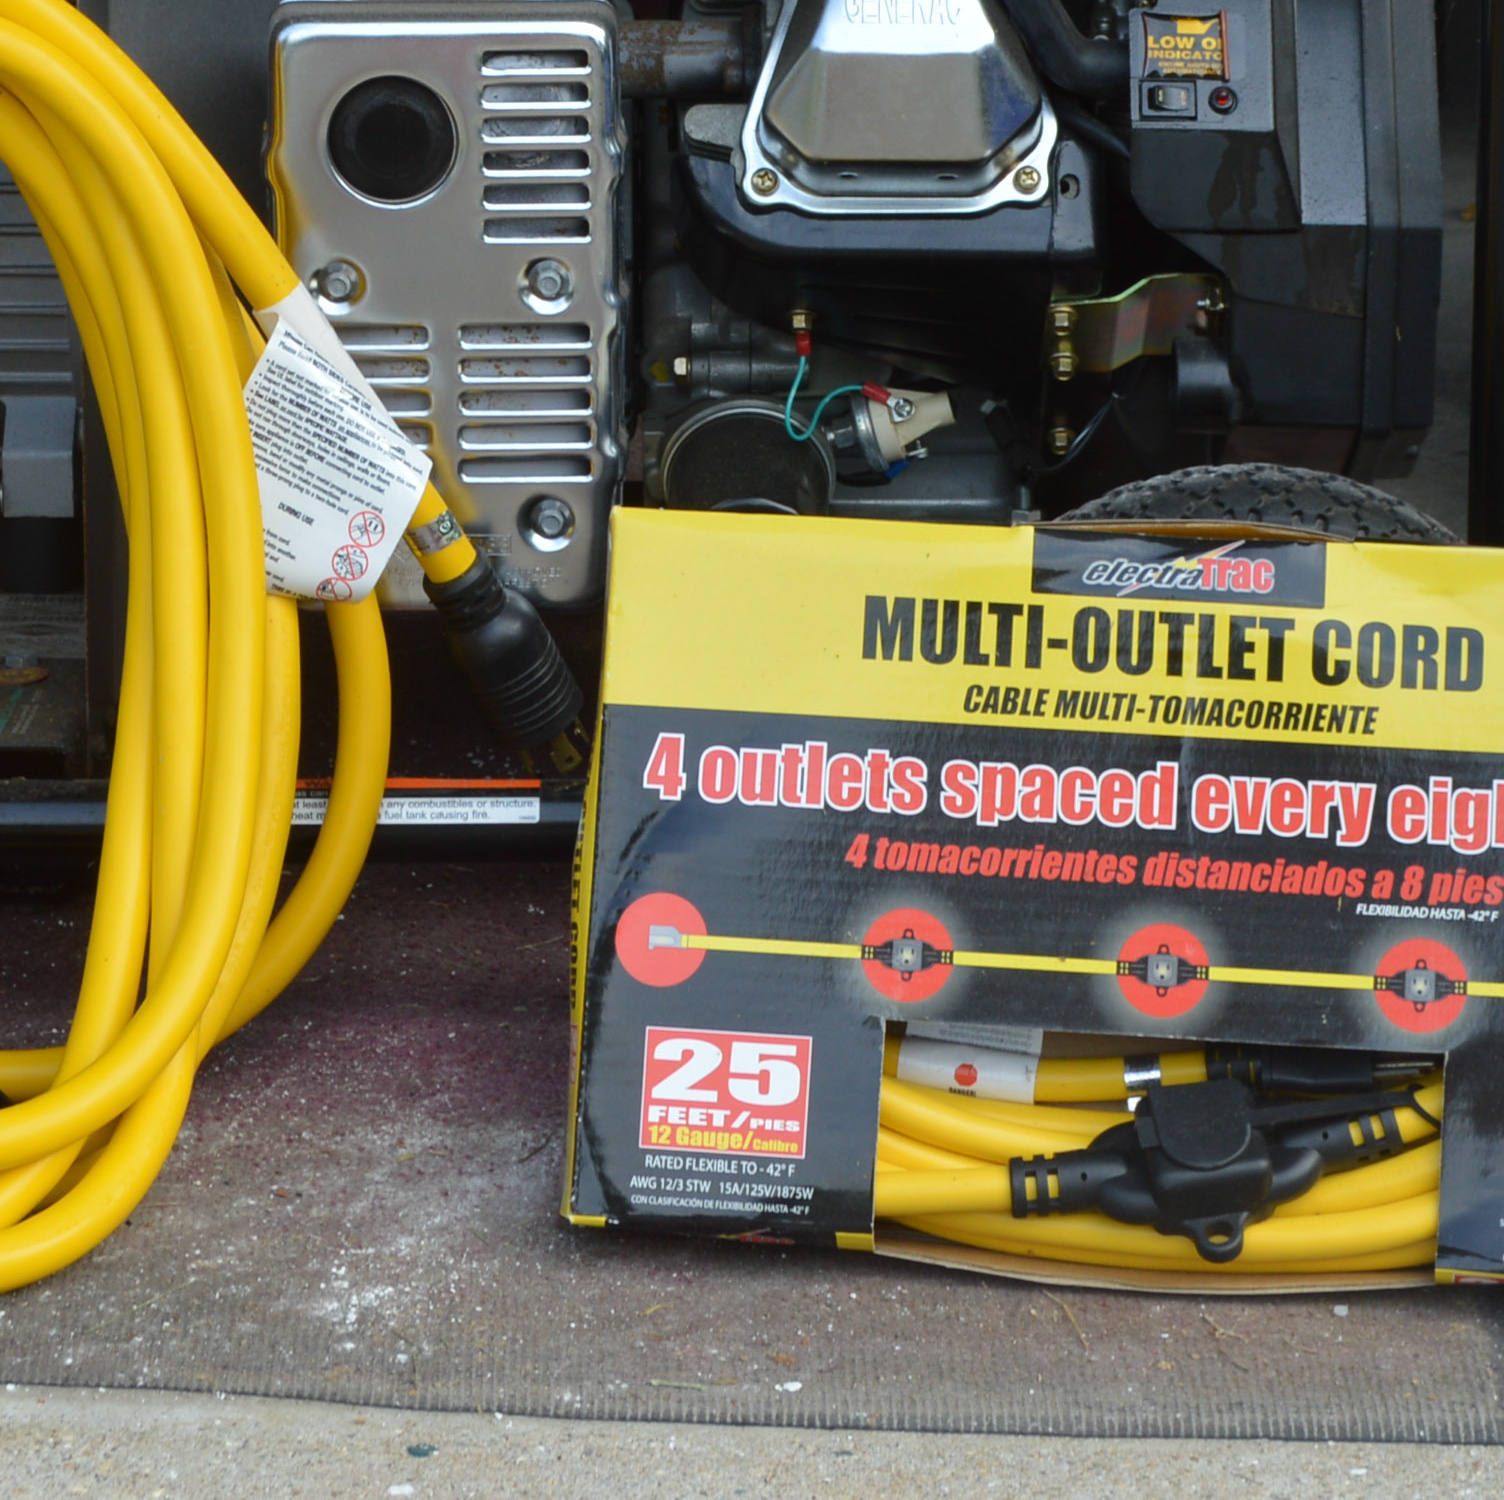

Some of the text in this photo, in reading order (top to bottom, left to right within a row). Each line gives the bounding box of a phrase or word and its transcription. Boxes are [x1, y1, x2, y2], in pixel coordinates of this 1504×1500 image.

[1148, 35, 1195, 49] LOW
[1148, 50, 1222, 60] INDICATO
[277, 500, 314, 526] DURING USE
[862, 595, 1485, 693] MULTI-OUTLET CORD
[963, 684, 1380, 736] CABLE MULTI-TOMACORRIENTE
[643, 732, 687, 800] 4
[698, 740, 928, 816] outlets
[940, 759, 1179, 831] spaced
[1191, 773, 1375, 848] every
[384, 810, 491, 822] fuel tank causing fire.
[386, 801, 404, 812] any
[407, 799, 474, 809] combustibles
[476, 801, 487, 809] or
[845, 833, 1504, 906] 4 tomacorrientes distanciados a 8 pies
[1356, 903, 1428, 920] FLEXIBILIDAD
[1429, 907, 1466, 921] HASTA
[651, 1037, 801, 1106] 25
[648, 1125, 671, 1145] 12
[645, 1155, 683, 1170] RATED
[685, 1157, 738, 1174] FLEXIBLE
[740, 1160, 758, 1175] TO
[788, 1164, 796, 1178] F
[630, 1175, 814, 1201] AWG 12/3 STW 15A/125V/1875W
[631, 1194, 647, 1205] CON
[704, 1198, 714, 1209] DE
[715, 1198, 764, 1213] FLEXIBILIDAD
[765, 1202, 788, 1214] HASTA
